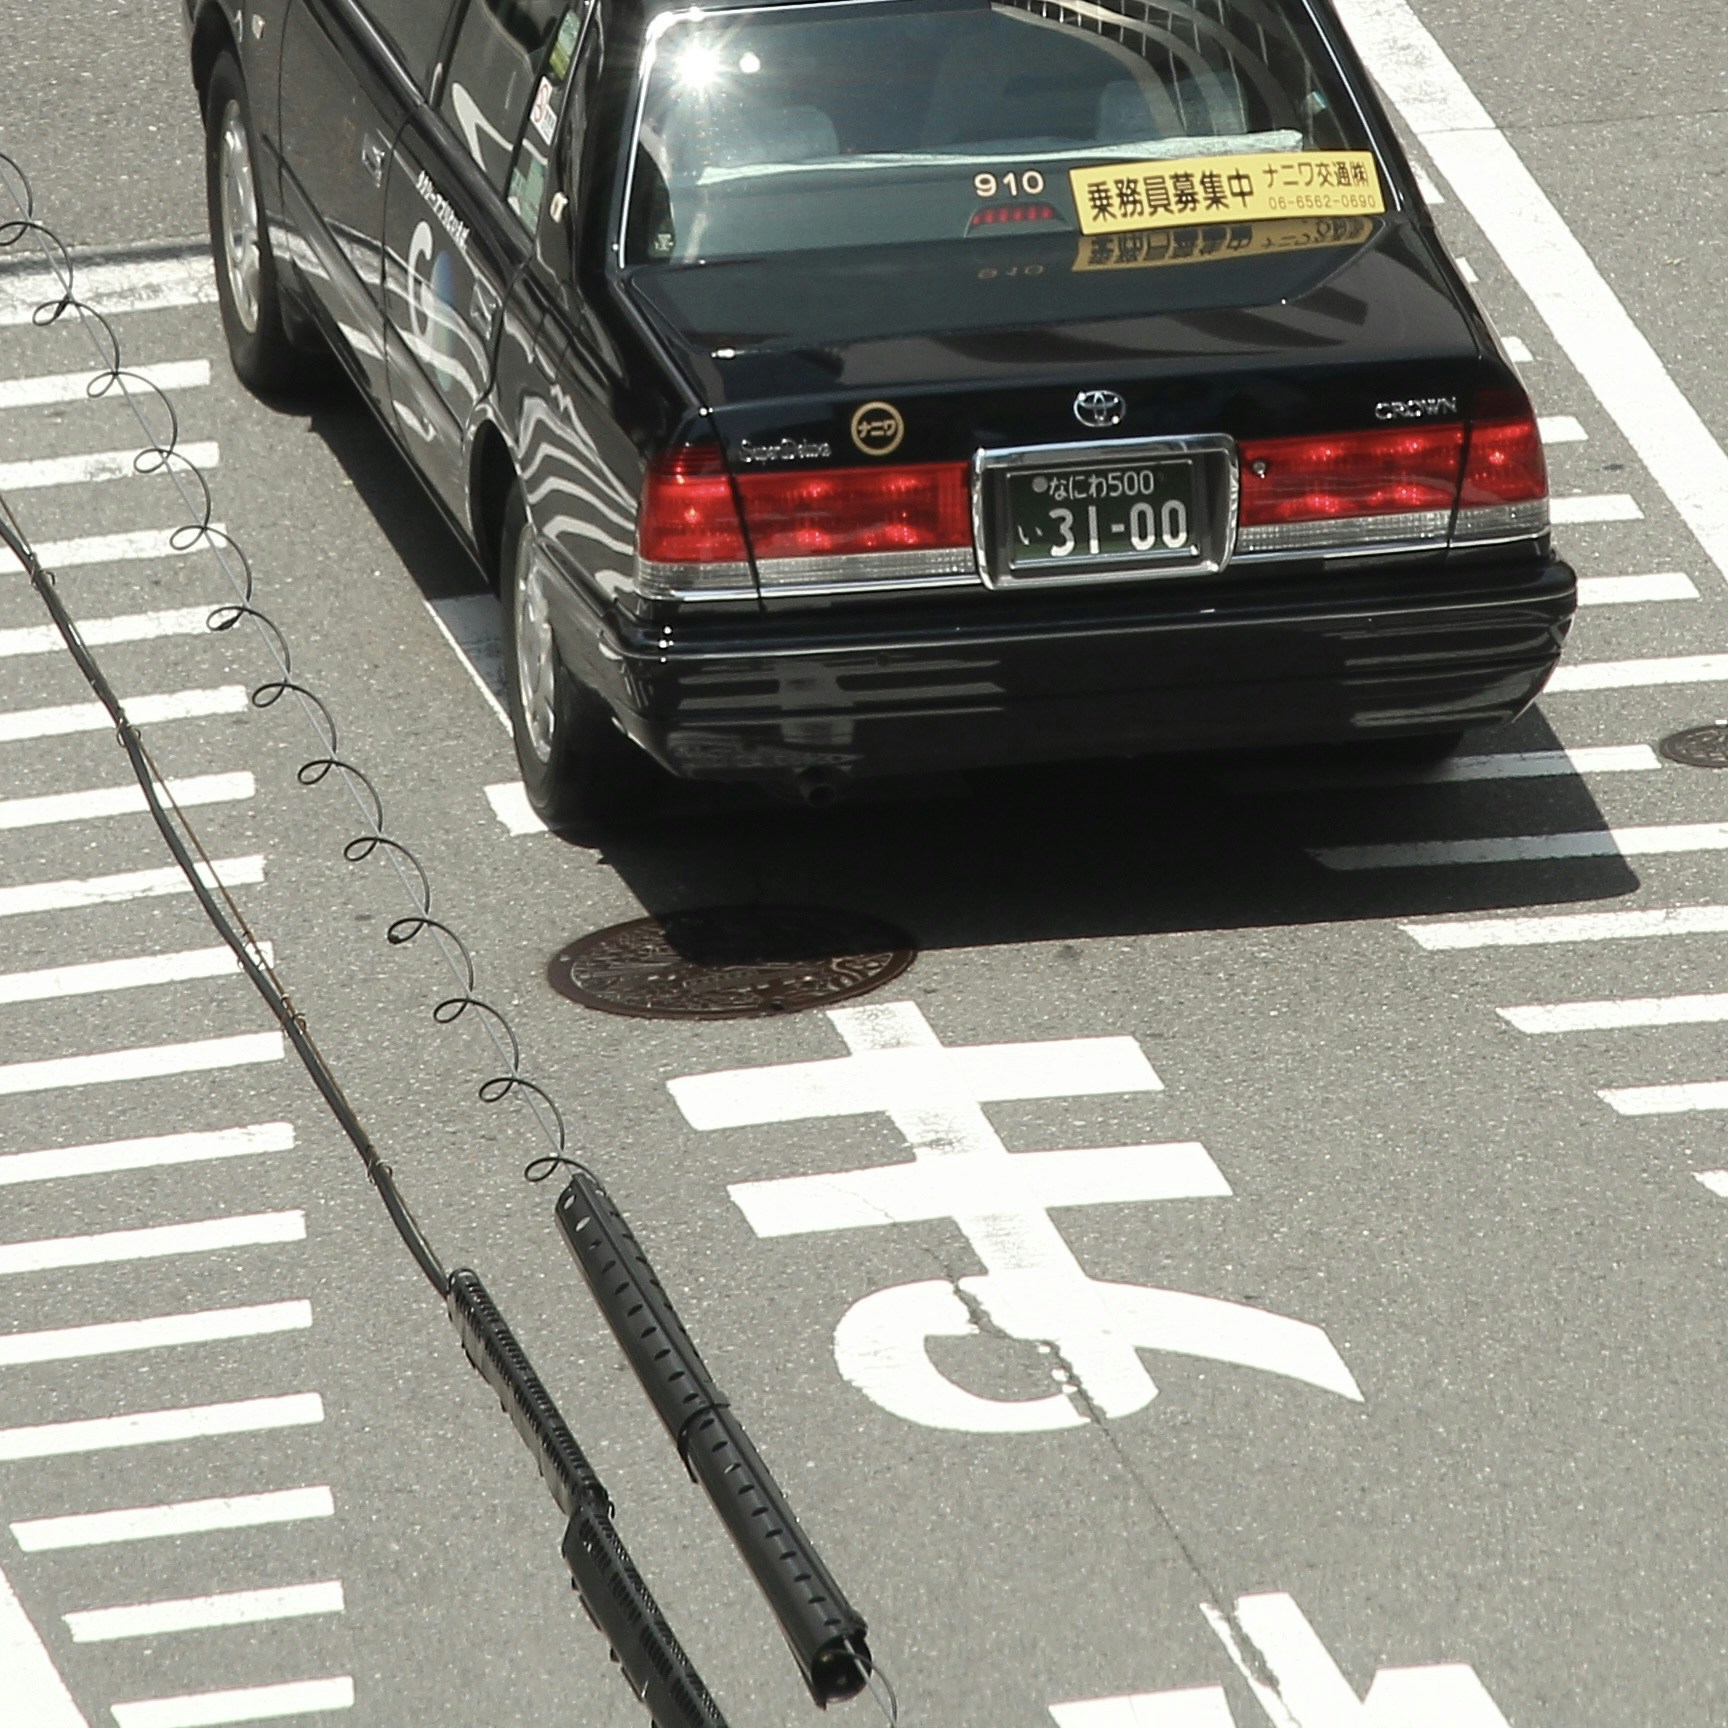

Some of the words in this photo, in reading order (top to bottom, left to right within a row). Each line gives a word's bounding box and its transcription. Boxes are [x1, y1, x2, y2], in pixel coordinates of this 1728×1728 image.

[974, 170, 1044, 197] 910
[1087, 168, 1254, 222] 乗務員募集中
[1268, 194, 1376, 210] 06-6562-0690
[1375, 396, 1457, 420] CROWN
[858, 419, 897, 438] ナニワ
